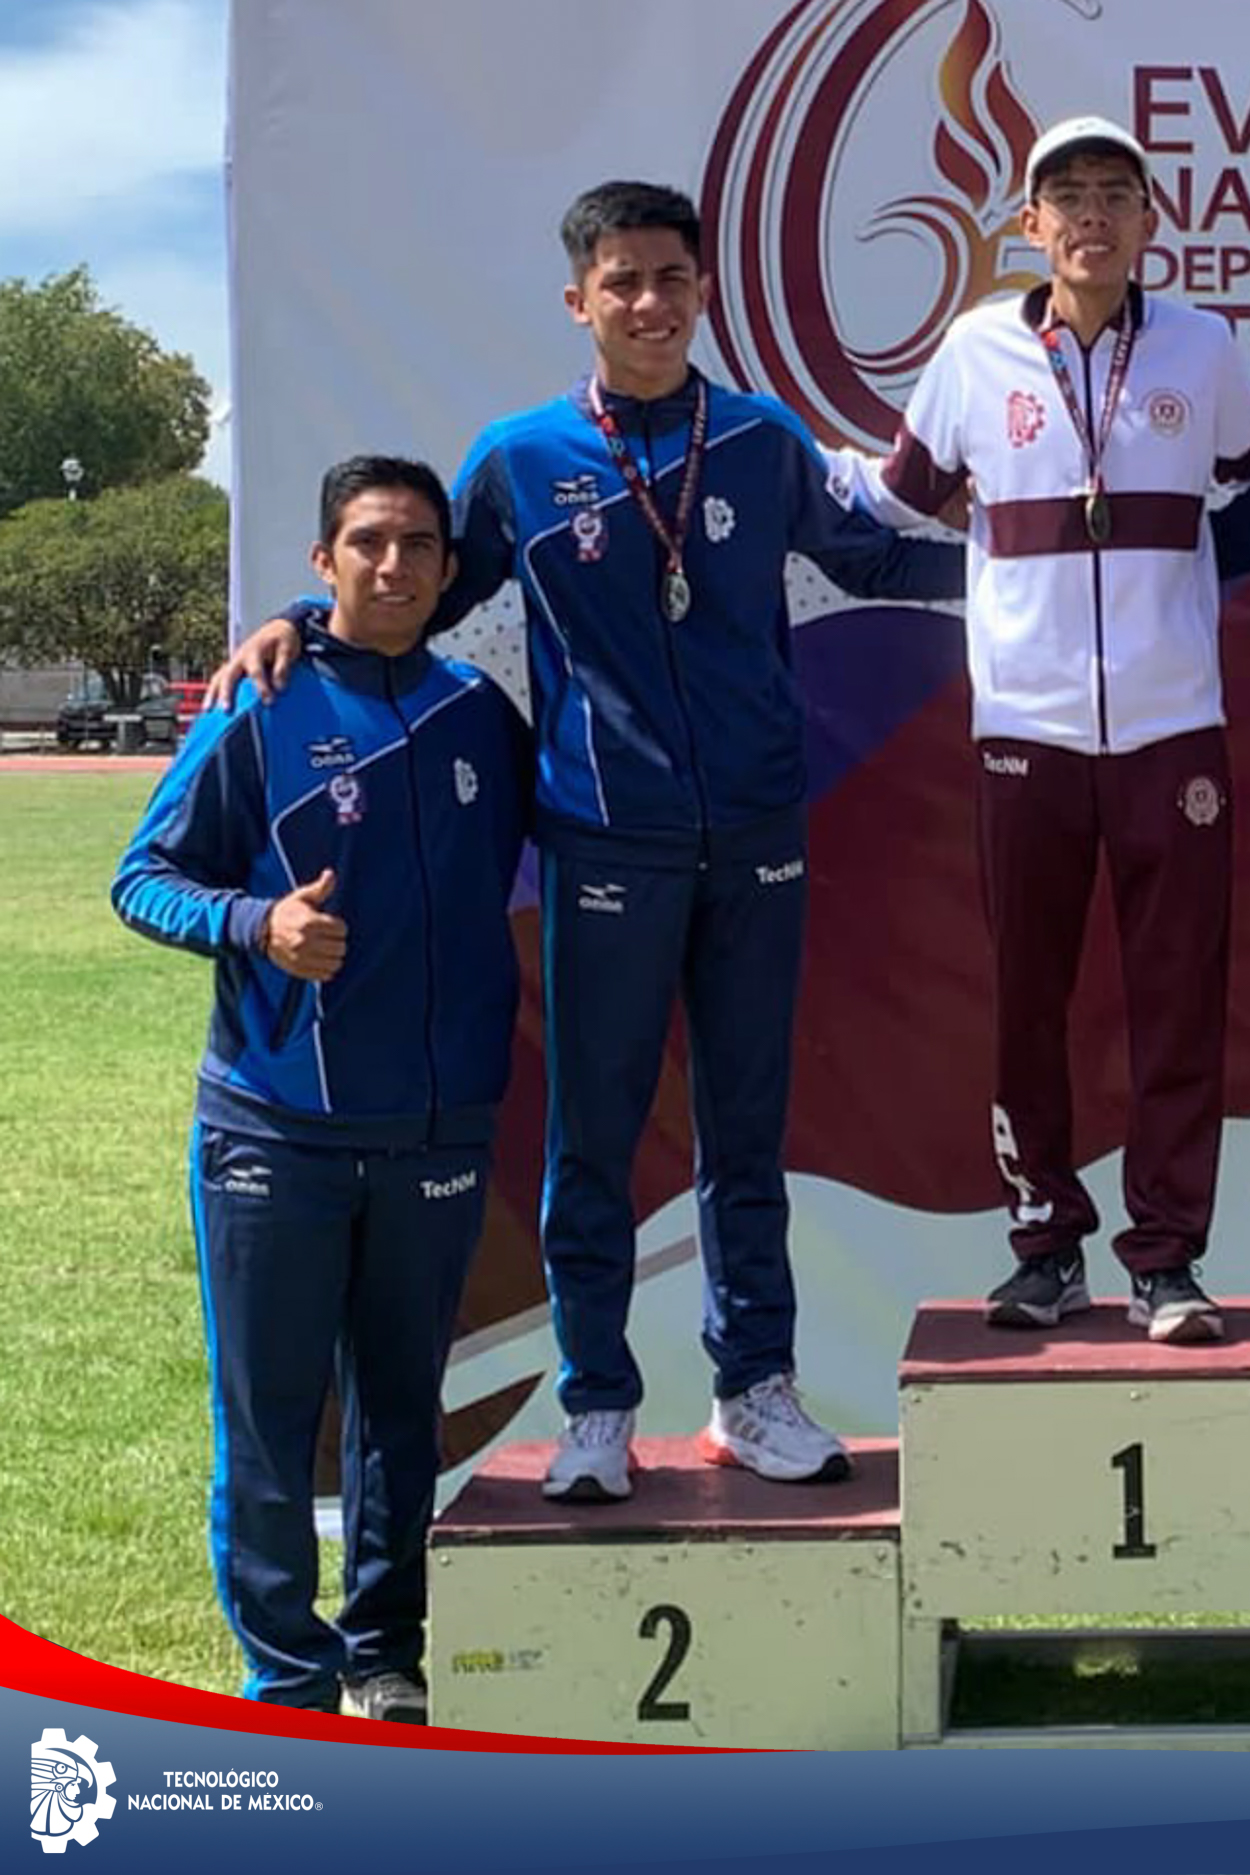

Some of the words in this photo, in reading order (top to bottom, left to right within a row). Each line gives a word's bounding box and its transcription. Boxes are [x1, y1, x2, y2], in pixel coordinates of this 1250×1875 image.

[420, 1170, 476, 1199] TecNM
[1111, 1441, 1157, 1559] 1
[637, 1603, 692, 1721] 2
